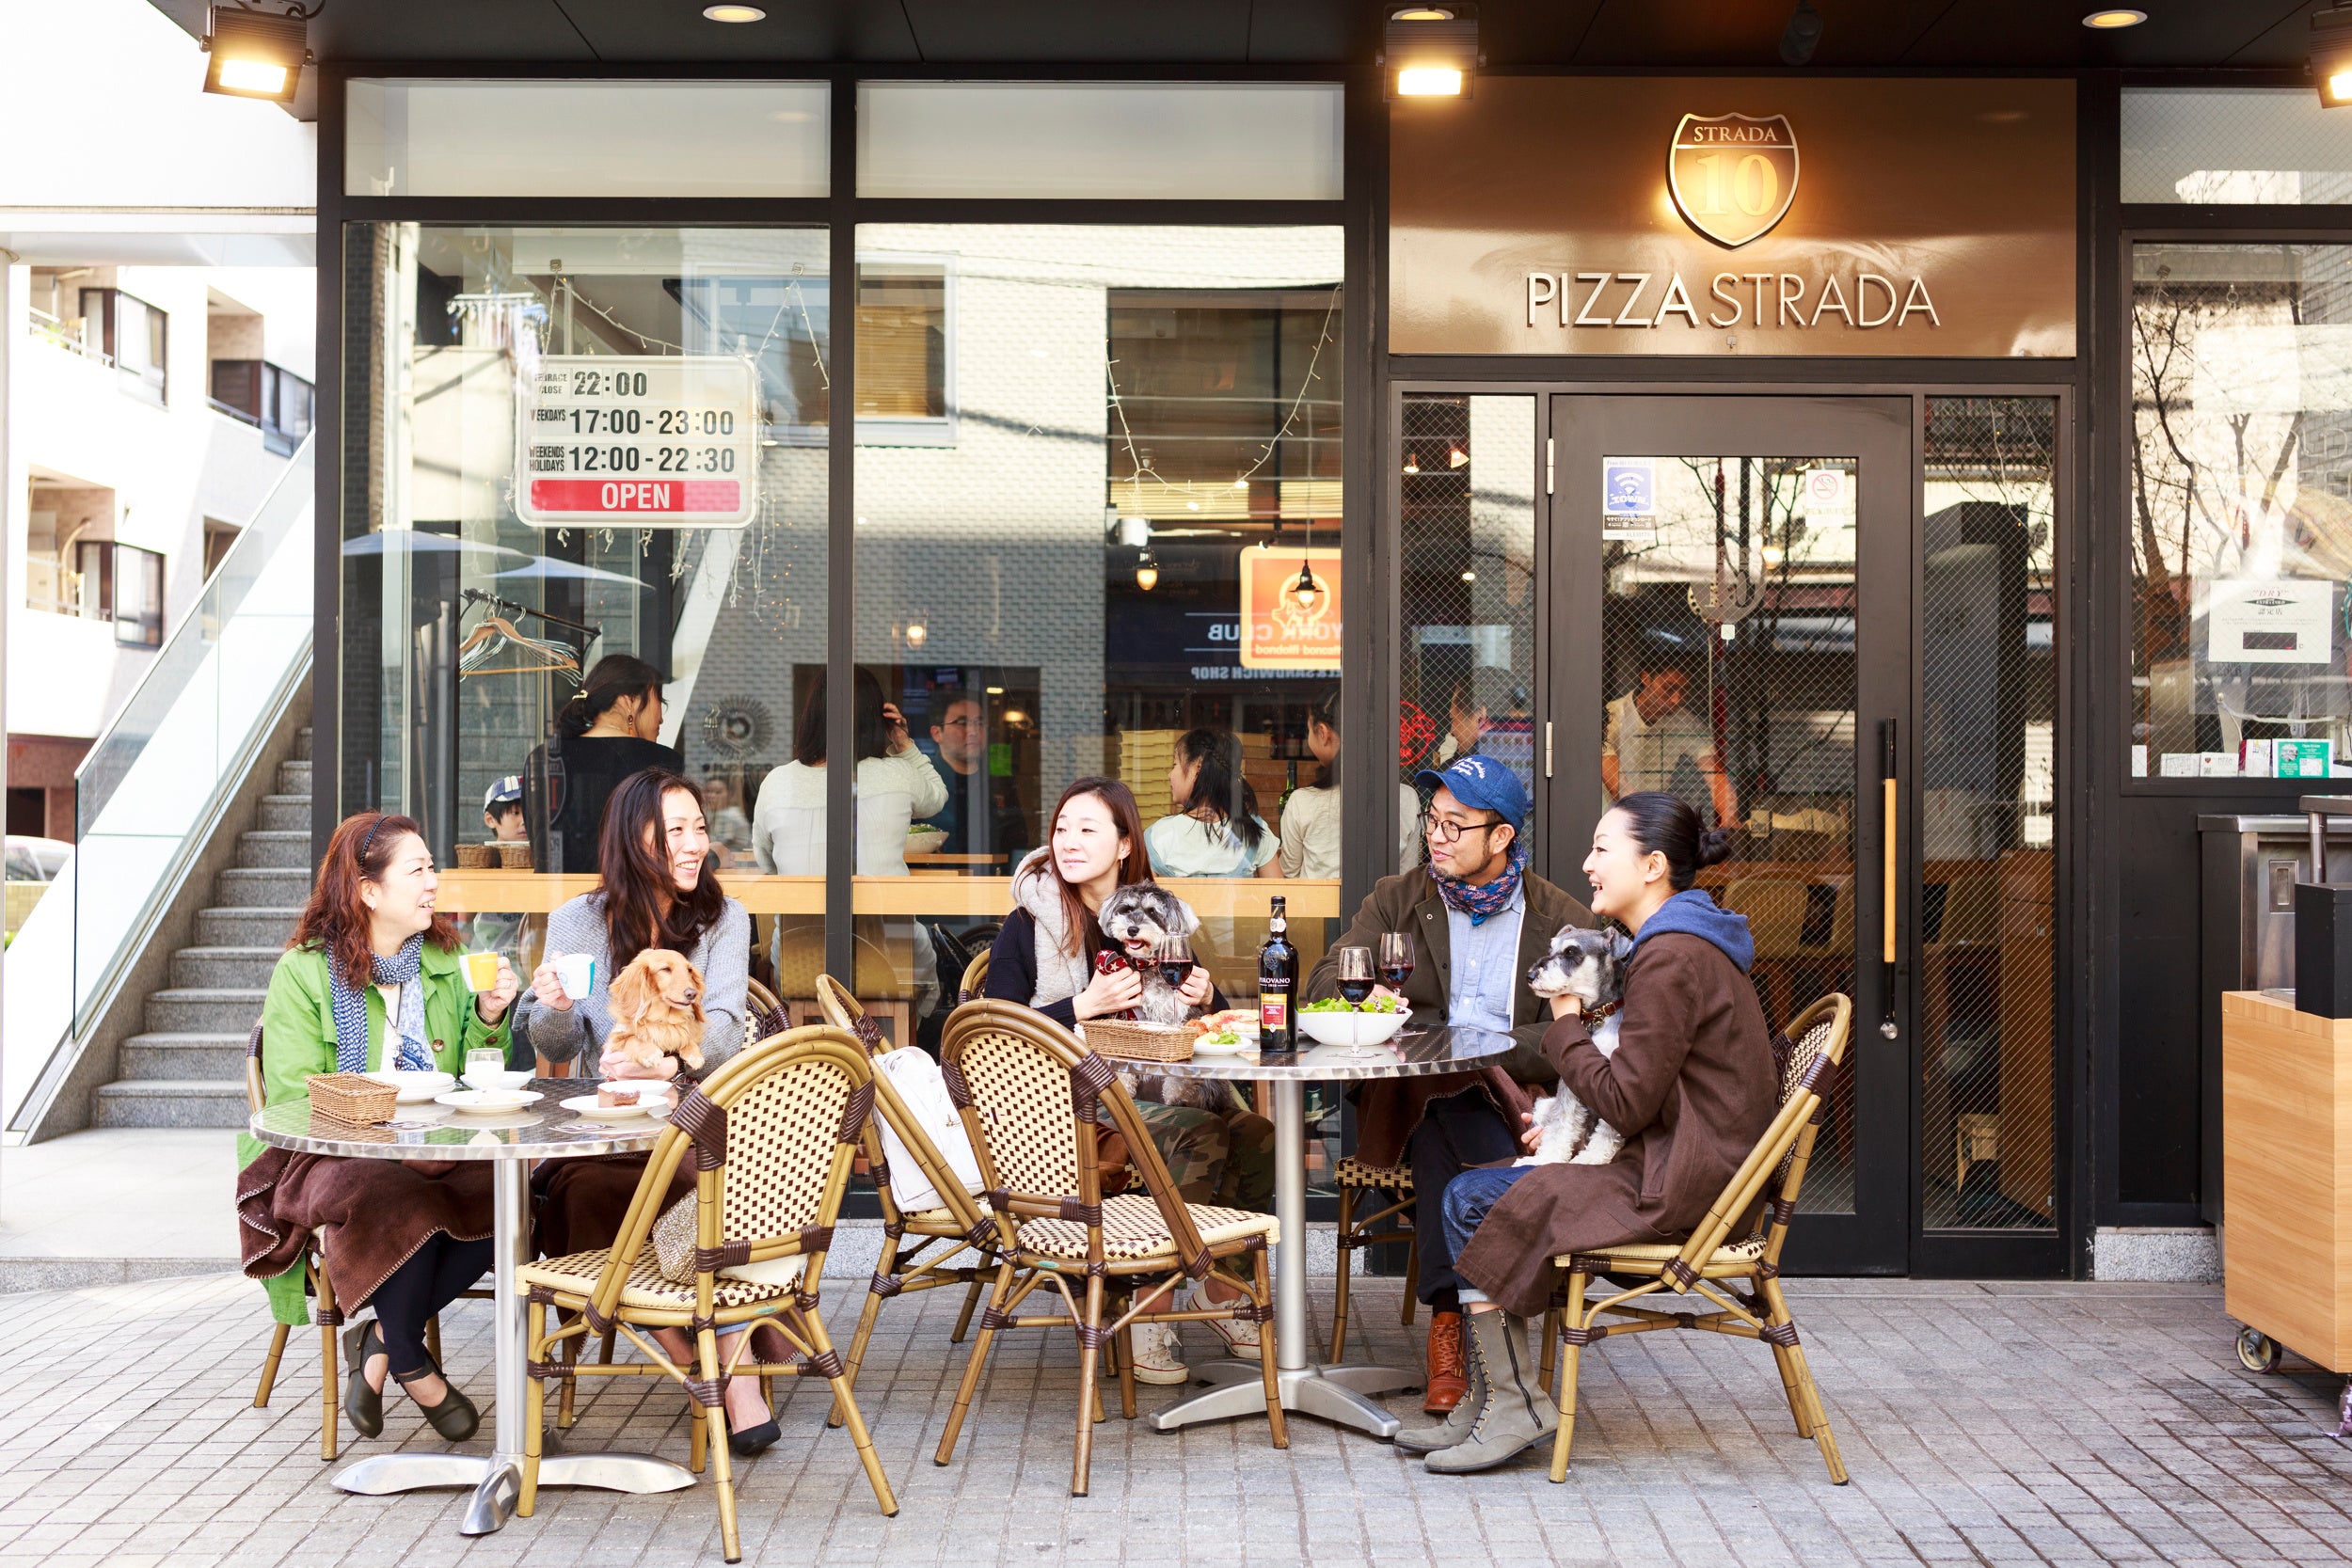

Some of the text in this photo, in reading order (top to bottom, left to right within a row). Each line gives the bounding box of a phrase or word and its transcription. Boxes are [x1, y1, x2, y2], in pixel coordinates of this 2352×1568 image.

[1692, 125, 1779, 143] STRADA
[1695, 153, 1778, 216] 10
[1528, 271, 1941, 326] PIZZA STRADA
[573, 371, 647, 397] 22:00
[530, 409, 566, 421] WEEKDAYS
[529, 446, 564, 458] WEEKENDS
[529, 459, 564, 472] HOLIDAYS
[601, 483, 671, 509] OPEN
